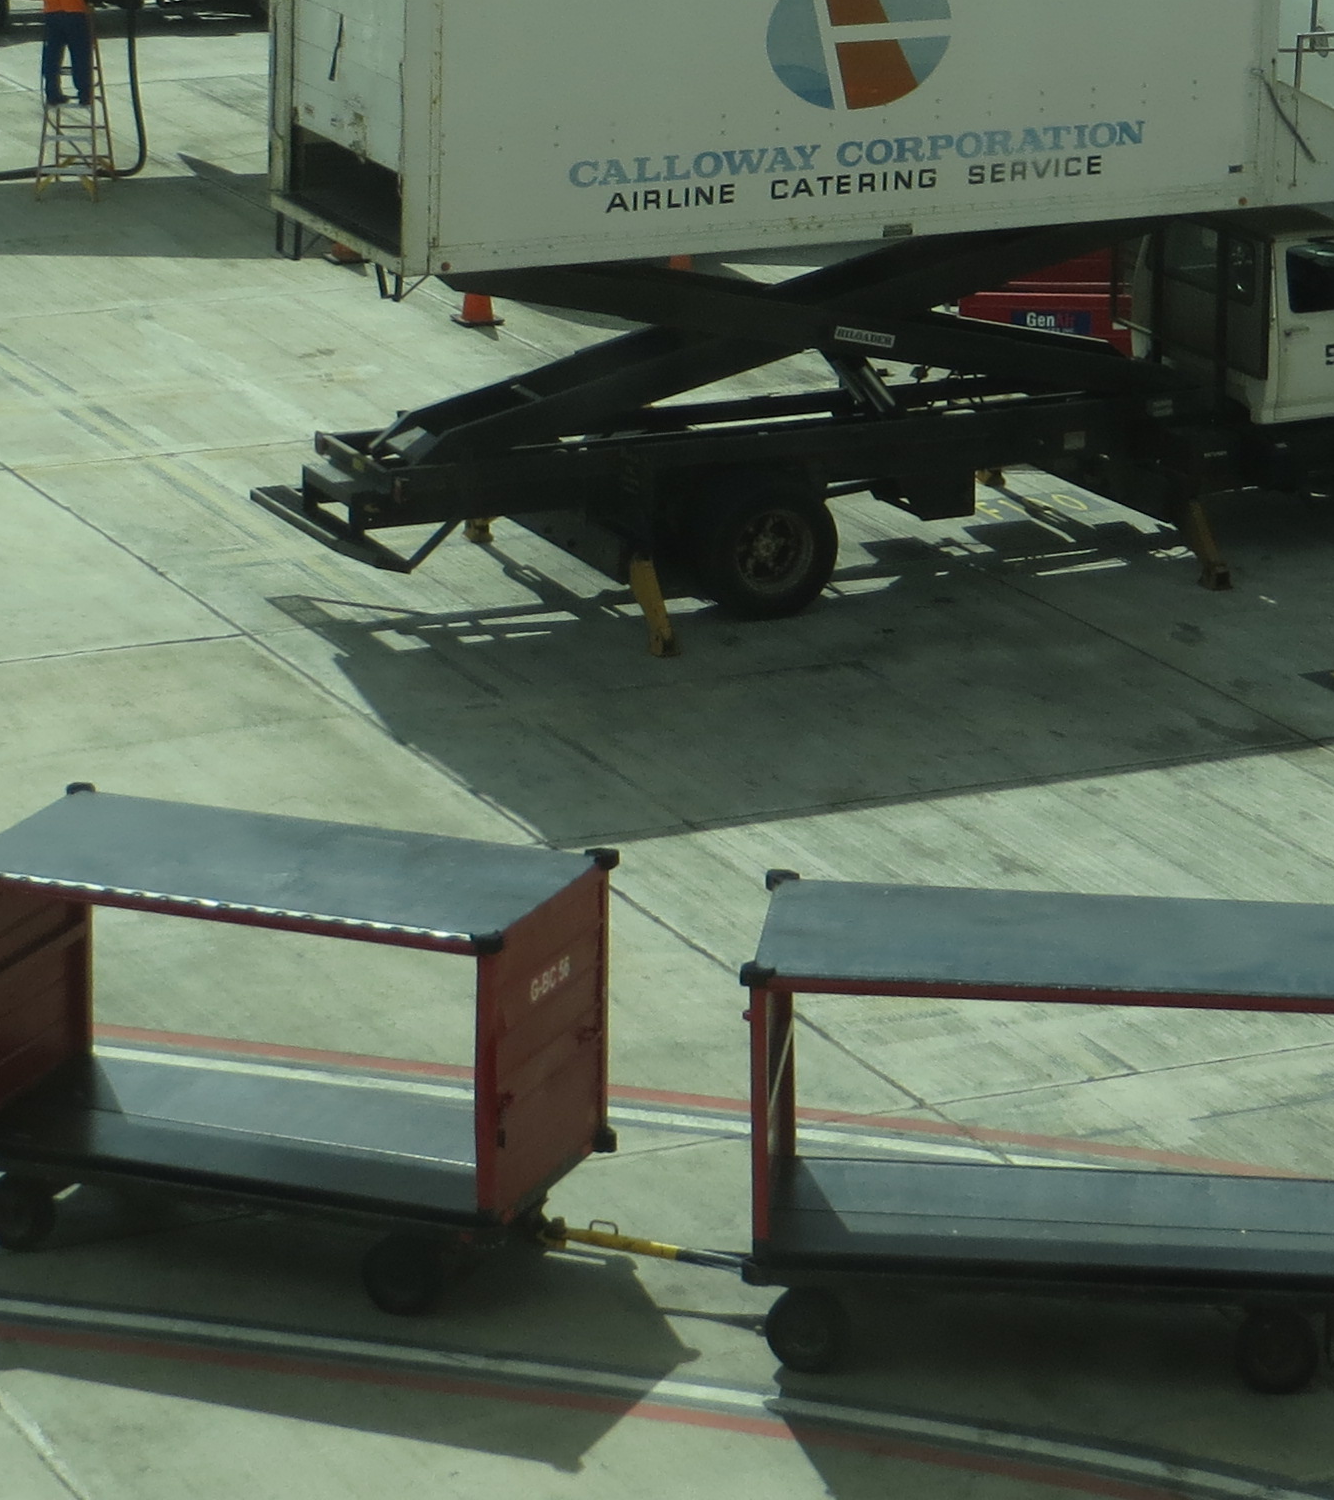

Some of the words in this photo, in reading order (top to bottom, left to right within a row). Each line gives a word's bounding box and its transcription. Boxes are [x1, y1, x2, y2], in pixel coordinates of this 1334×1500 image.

[568, 144, 821, 188] CALLOWAY
[835, 119, 1145, 167] CORPORATION
[605, 183, 735, 213] AIRLINE
[770, 168, 938, 200] CATERING
[967, 155, 1103, 185] SERVICE
